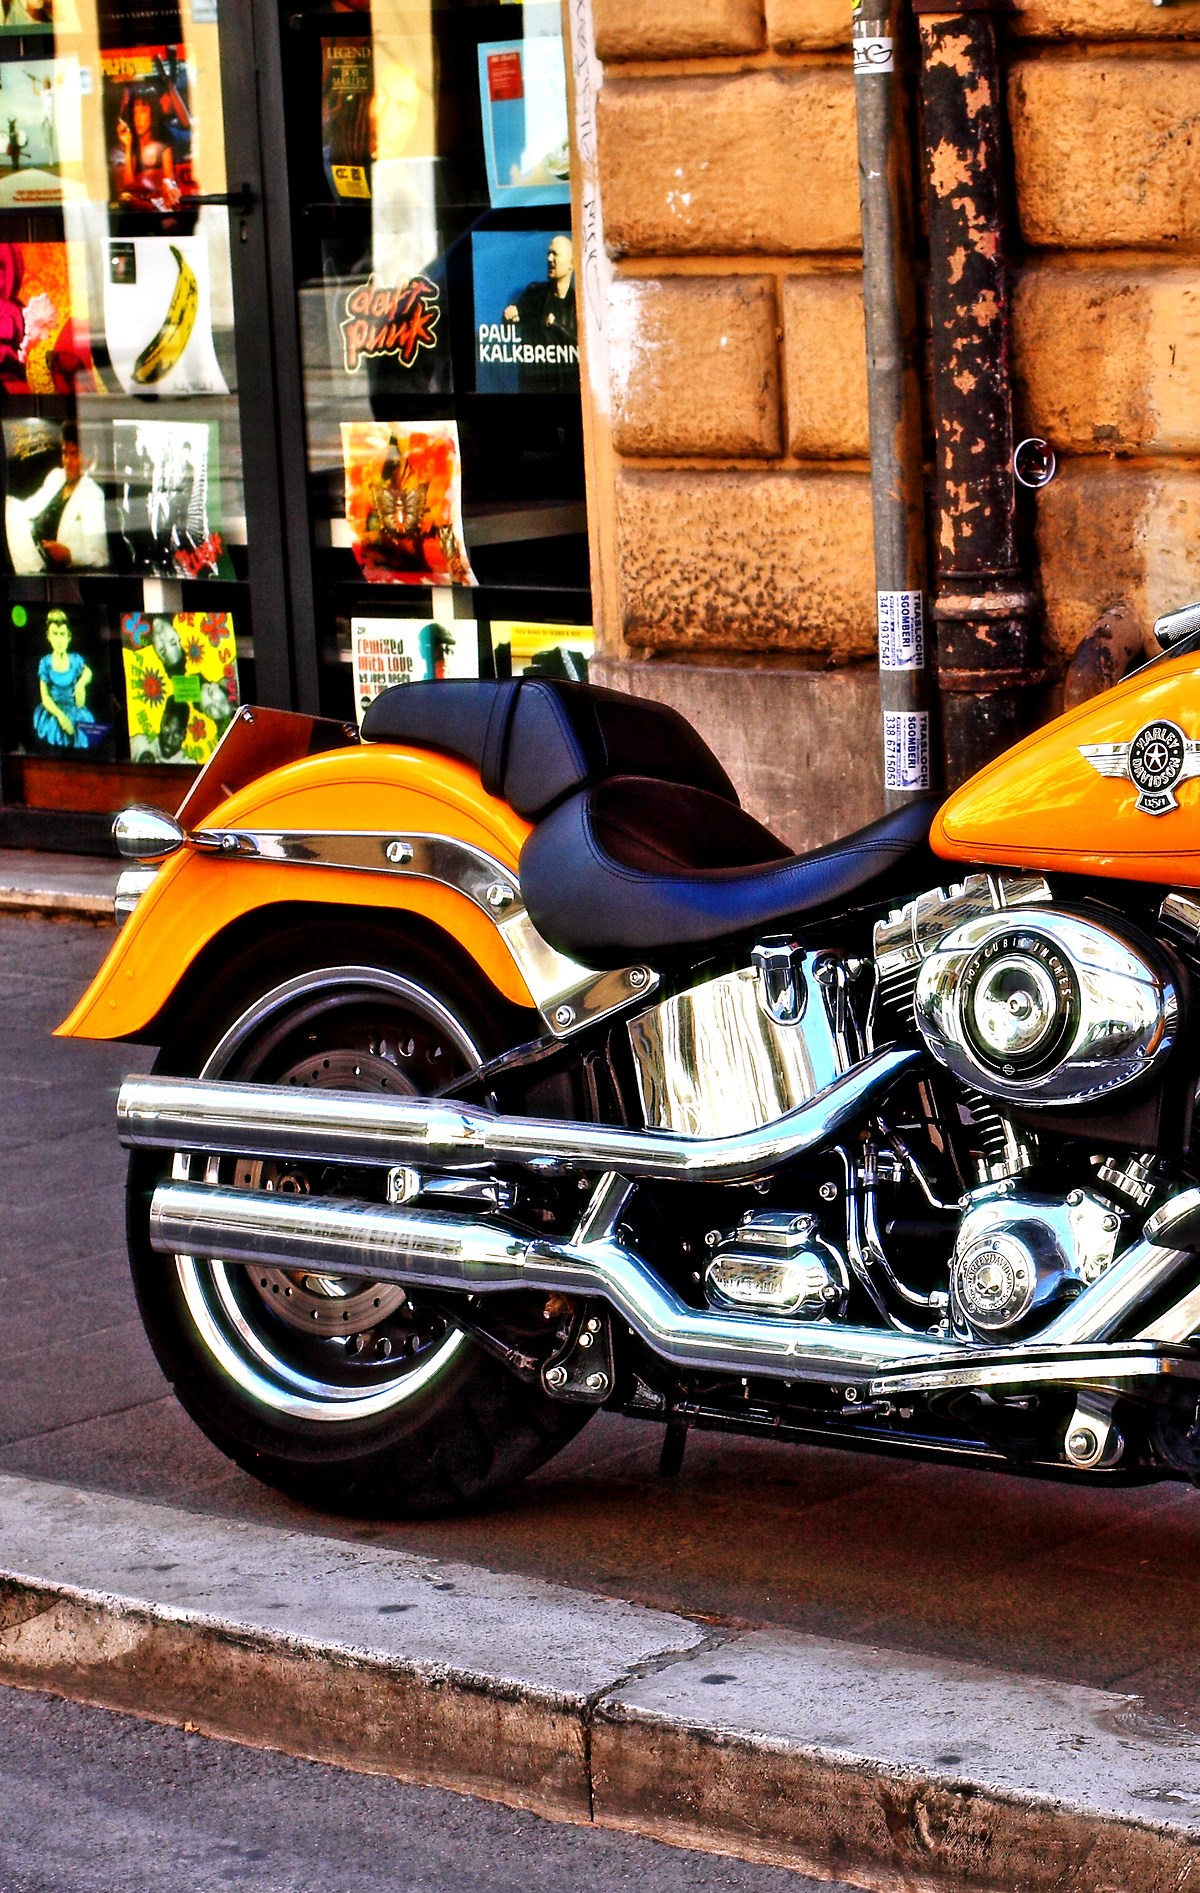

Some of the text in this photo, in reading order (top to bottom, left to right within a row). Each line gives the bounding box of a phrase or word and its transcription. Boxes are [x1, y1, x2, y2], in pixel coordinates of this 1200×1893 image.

[327, 46, 373, 59] LEGEND
[346, 303, 434, 366] punk
[479, 323, 522, 343] PAUL
[479, 344, 579, 364] KALKBRENN
[879, 595, 891, 666] 347 1937542
[900, 595, 911, 648] SGOMBERI
[913, 594, 924, 666] TRASLOCHI
[357, 639, 404, 655] remixed
[358, 656, 385, 672] with
[885, 716, 896, 787] 338 6715053
[907, 716, 916, 769] SGOMBERI
[920, 715, 928, 787] TRASLOCHI
[1136, 727, 1180, 751] HARLEY
[1132, 757, 1181, 788] DAVIDSON
[1144, 797, 1167, 809] USA
[964, 937, 1072, 996] 103 CUBIC INCHES
